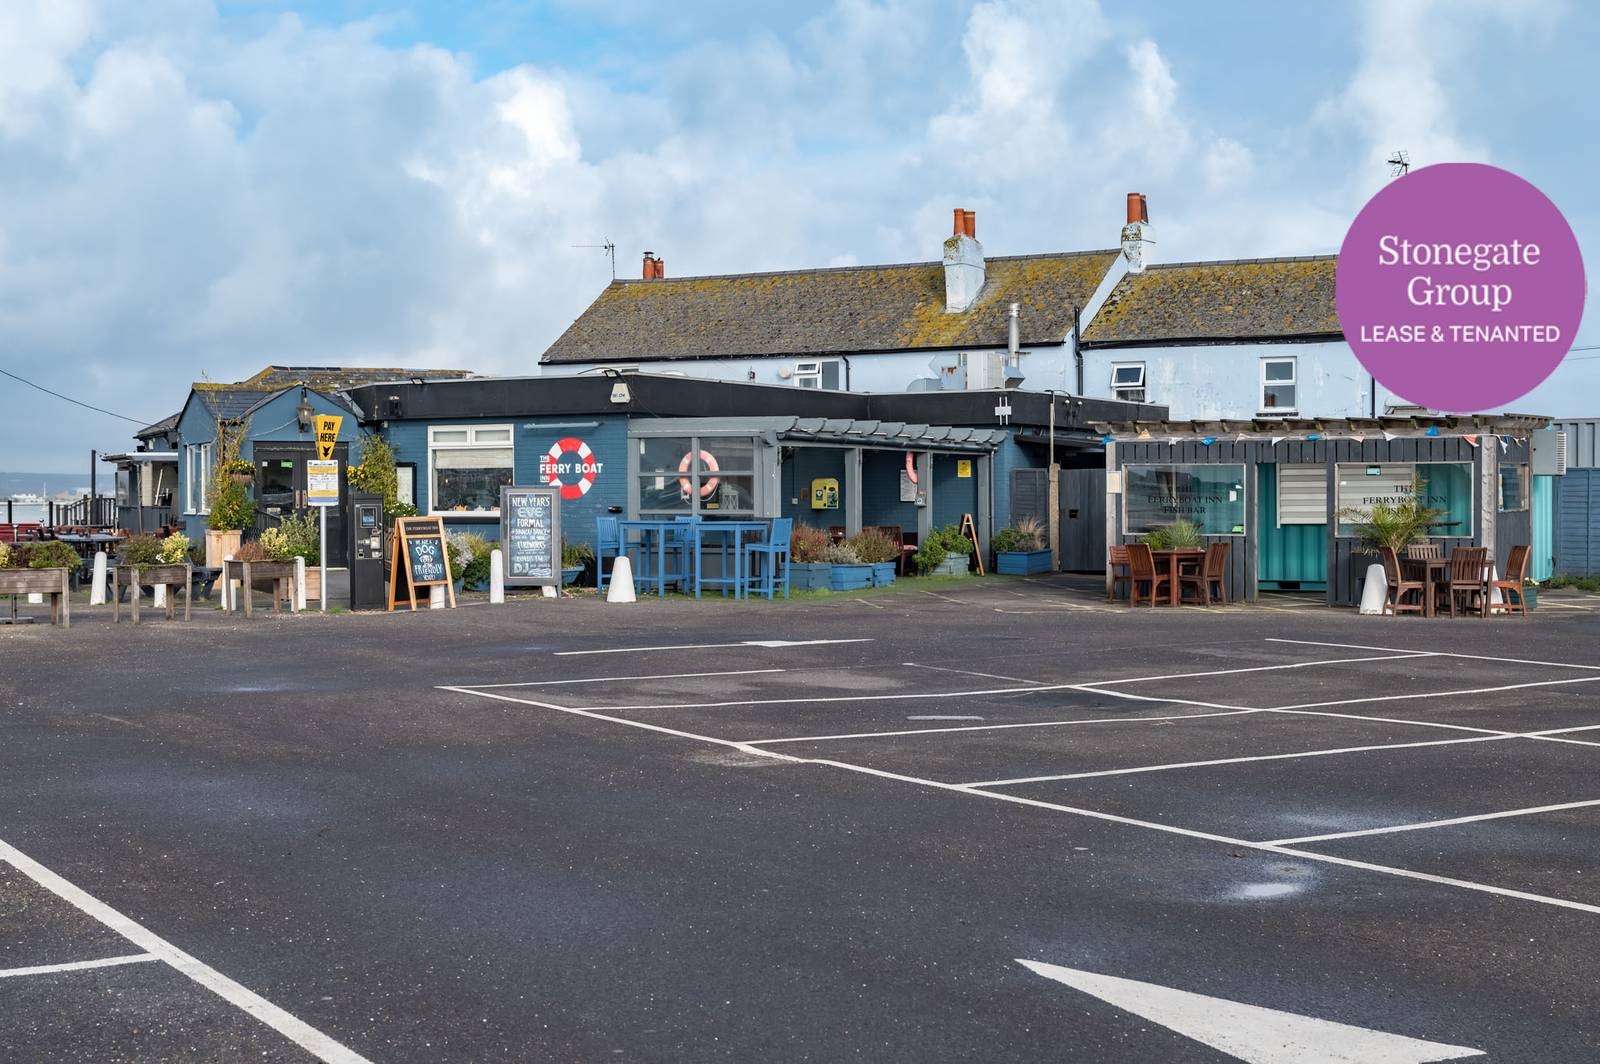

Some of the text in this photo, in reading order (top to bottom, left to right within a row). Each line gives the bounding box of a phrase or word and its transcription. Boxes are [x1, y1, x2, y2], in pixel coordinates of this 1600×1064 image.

[323, 421, 335, 431] PAY
[320, 433, 336, 442] HERE
[539, 463, 603, 474] FERRY BOAT
[512, 497, 550, 507] NEW YEAR'S
[1204, 495, 1222, 504] INN
[1427, 495, 1447, 505] INN
[518, 507, 544, 517] EVE
[1188, 506, 1207, 514] BAR
[516, 518, 545, 528] FORMAL
[415, 544, 435, 556] DOG
[414, 563, 442, 575] FRIENDLY
[513, 562, 529, 574] DJ
